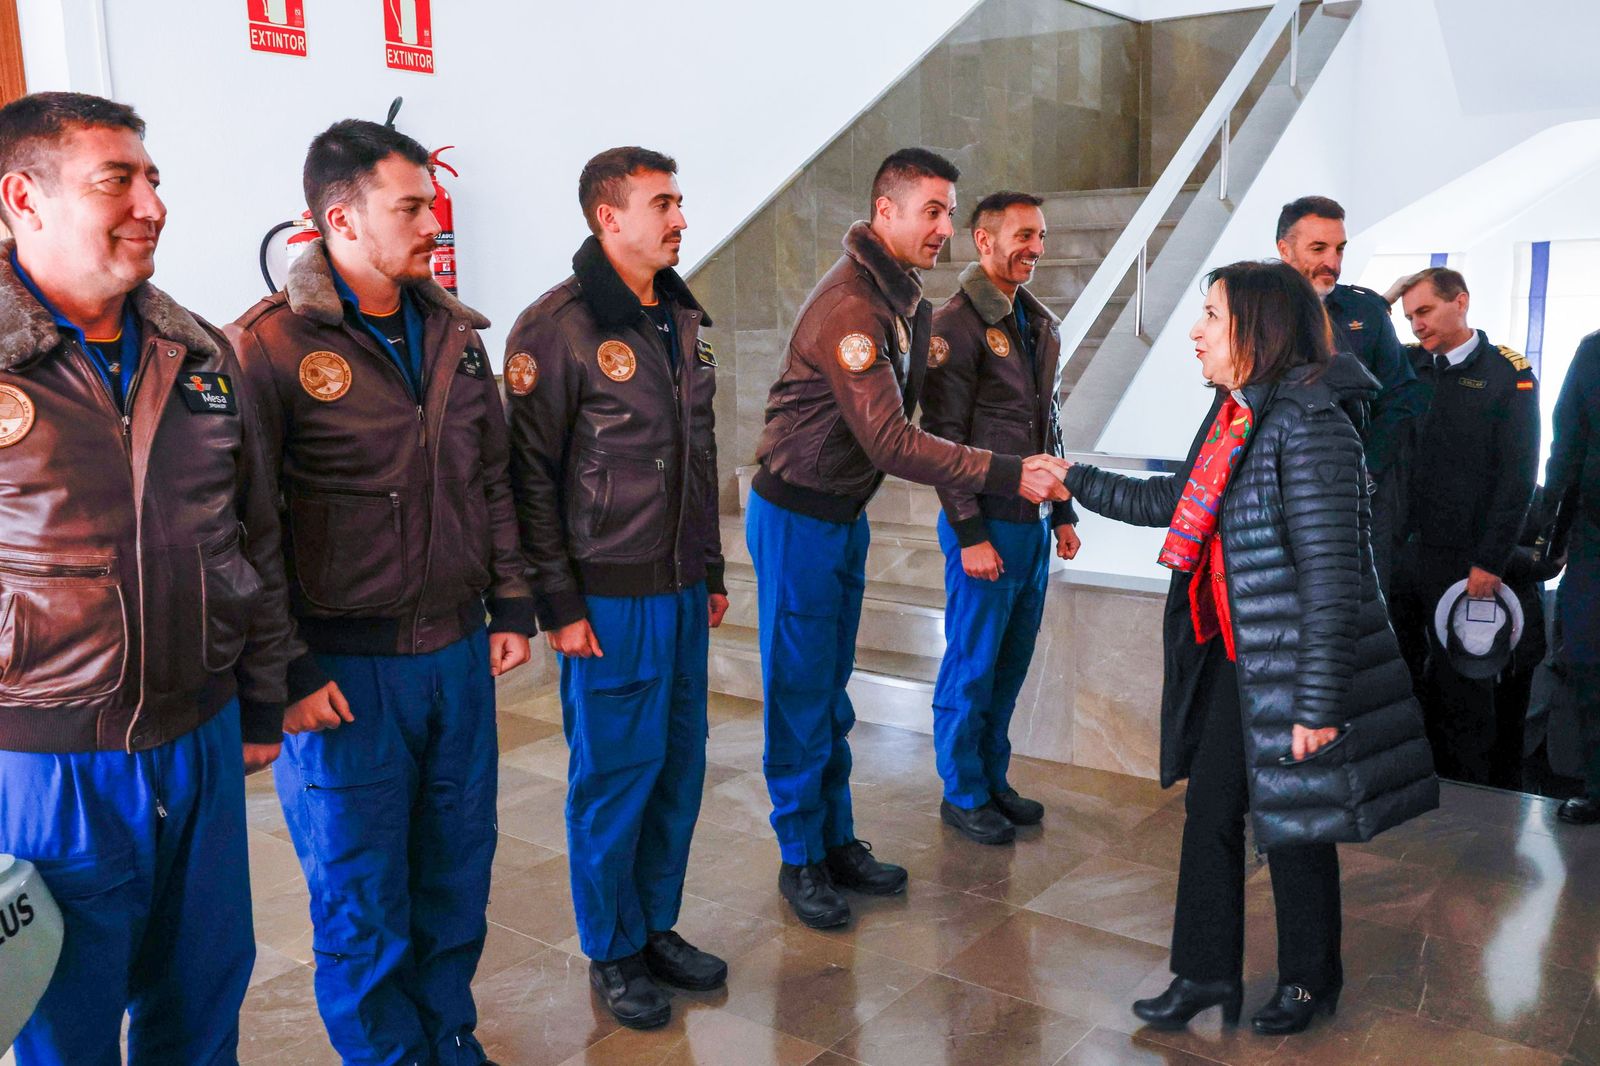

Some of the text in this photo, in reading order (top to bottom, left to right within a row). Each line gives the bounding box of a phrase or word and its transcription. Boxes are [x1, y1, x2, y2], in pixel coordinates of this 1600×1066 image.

[250, 29, 306, 51] EXTINTOR
[387, 49, 433, 69] EXTINTOR
[201, 392, 228, 404] Mesa
[0, 892, 35, 945] US
